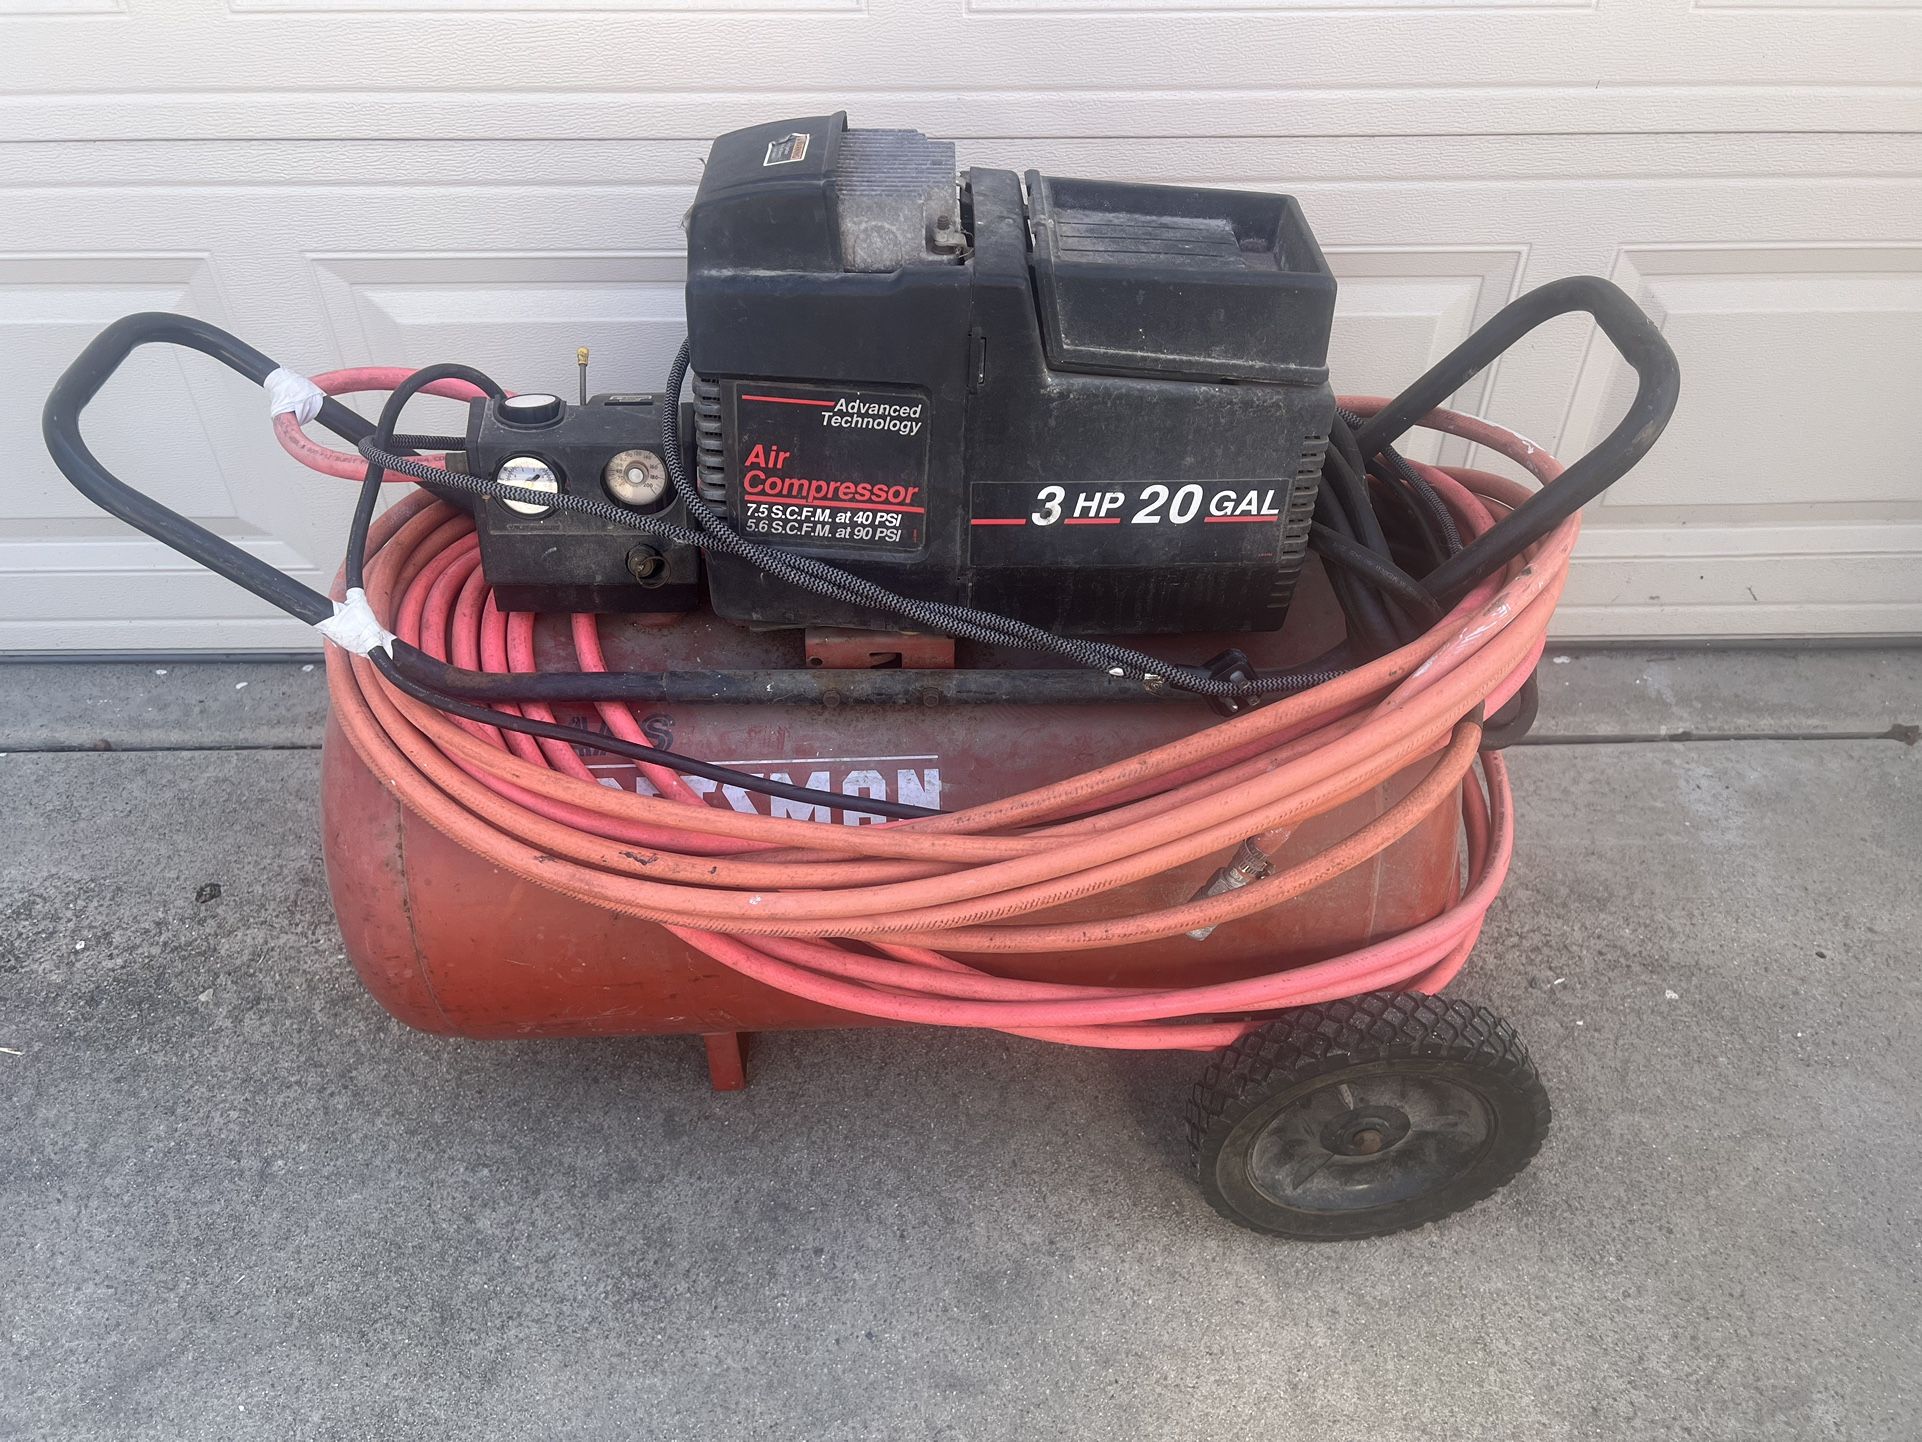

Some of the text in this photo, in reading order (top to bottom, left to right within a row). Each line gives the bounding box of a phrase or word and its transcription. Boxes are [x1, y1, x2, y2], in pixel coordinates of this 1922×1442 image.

[833, 398, 922, 418] Advanced
[821, 411, 922, 436] Technology
[744, 444, 790, 469] Air
[743, 469, 919, 504] Compressor
[746, 503, 902, 527] 7.5 S.C.F.M. at 40 PSI
[1031, 484, 1281, 527] 3 HP 20 GAL
[745, 519, 769, 532] 5.6
[770, 521, 833, 537] S.C.F.M.
[835, 526, 852, 539] at
[853, 526, 873, 540] 90
[875, 528, 902, 542] PSI
